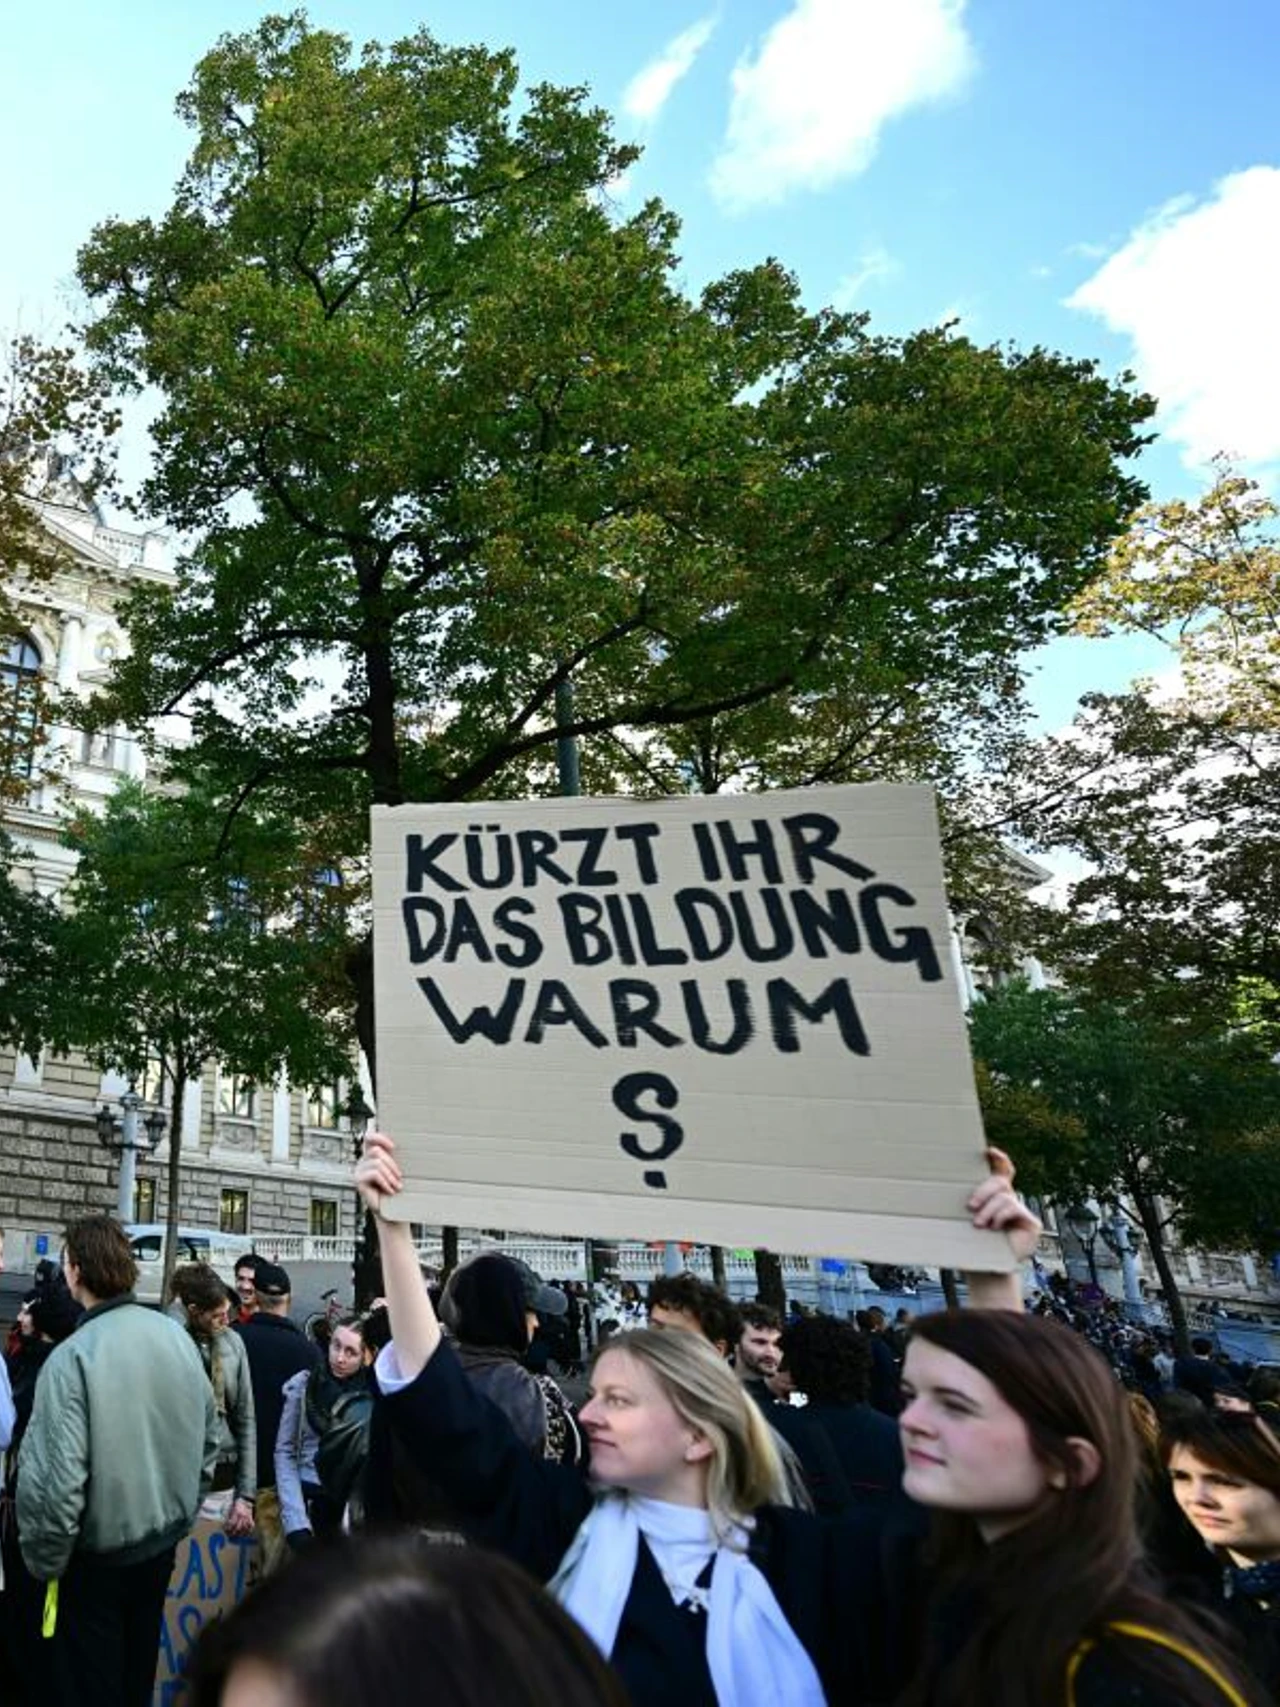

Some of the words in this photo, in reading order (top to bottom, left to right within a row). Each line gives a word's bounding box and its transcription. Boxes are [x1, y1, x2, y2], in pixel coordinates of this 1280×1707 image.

[406, 822, 662, 893] KÜRZT
[691, 812, 877, 885] IHR
[402, 896, 544, 969] DAS
[557, 883, 945, 983] BILDUNG
[416, 976, 872, 1057] WARUM
